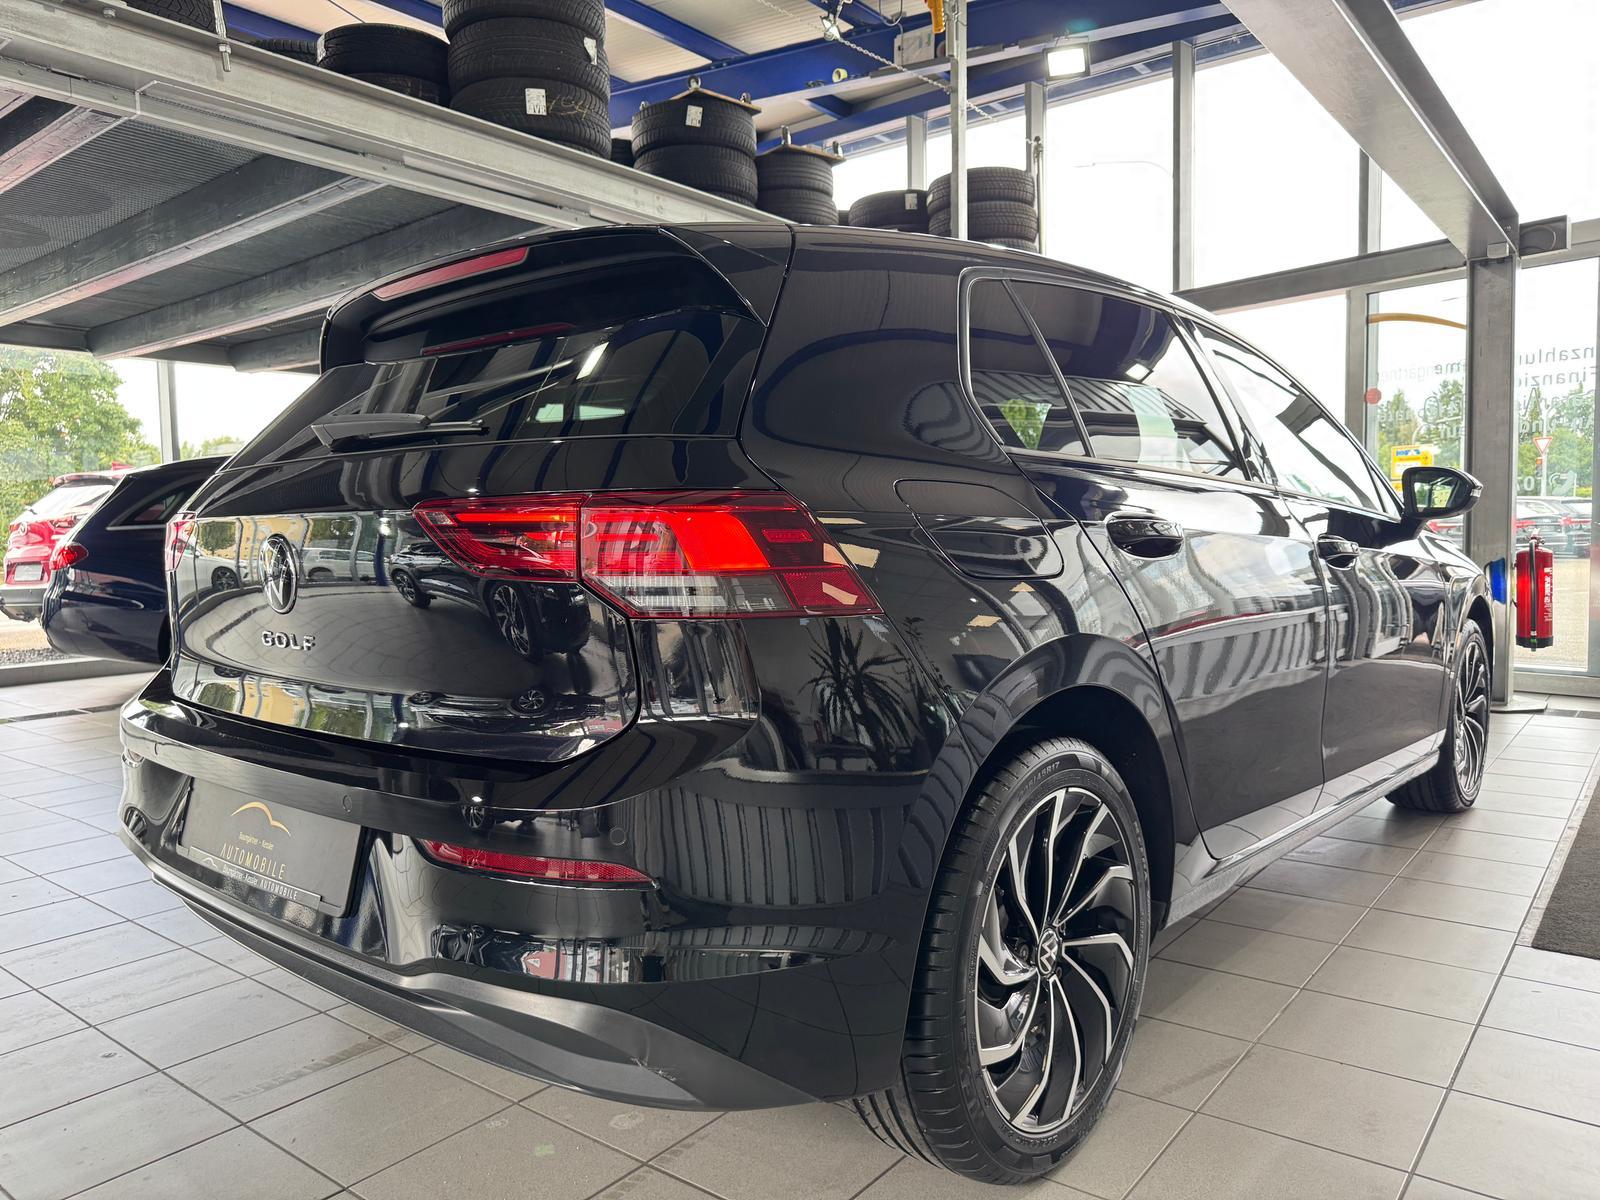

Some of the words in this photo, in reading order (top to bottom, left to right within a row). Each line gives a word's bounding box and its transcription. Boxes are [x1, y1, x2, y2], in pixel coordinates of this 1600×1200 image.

[261, 630, 316, 652] GOLF
[220, 843, 286, 880] AUTOMOBILE
[260, 879, 298, 900] AUTOMOBILE
